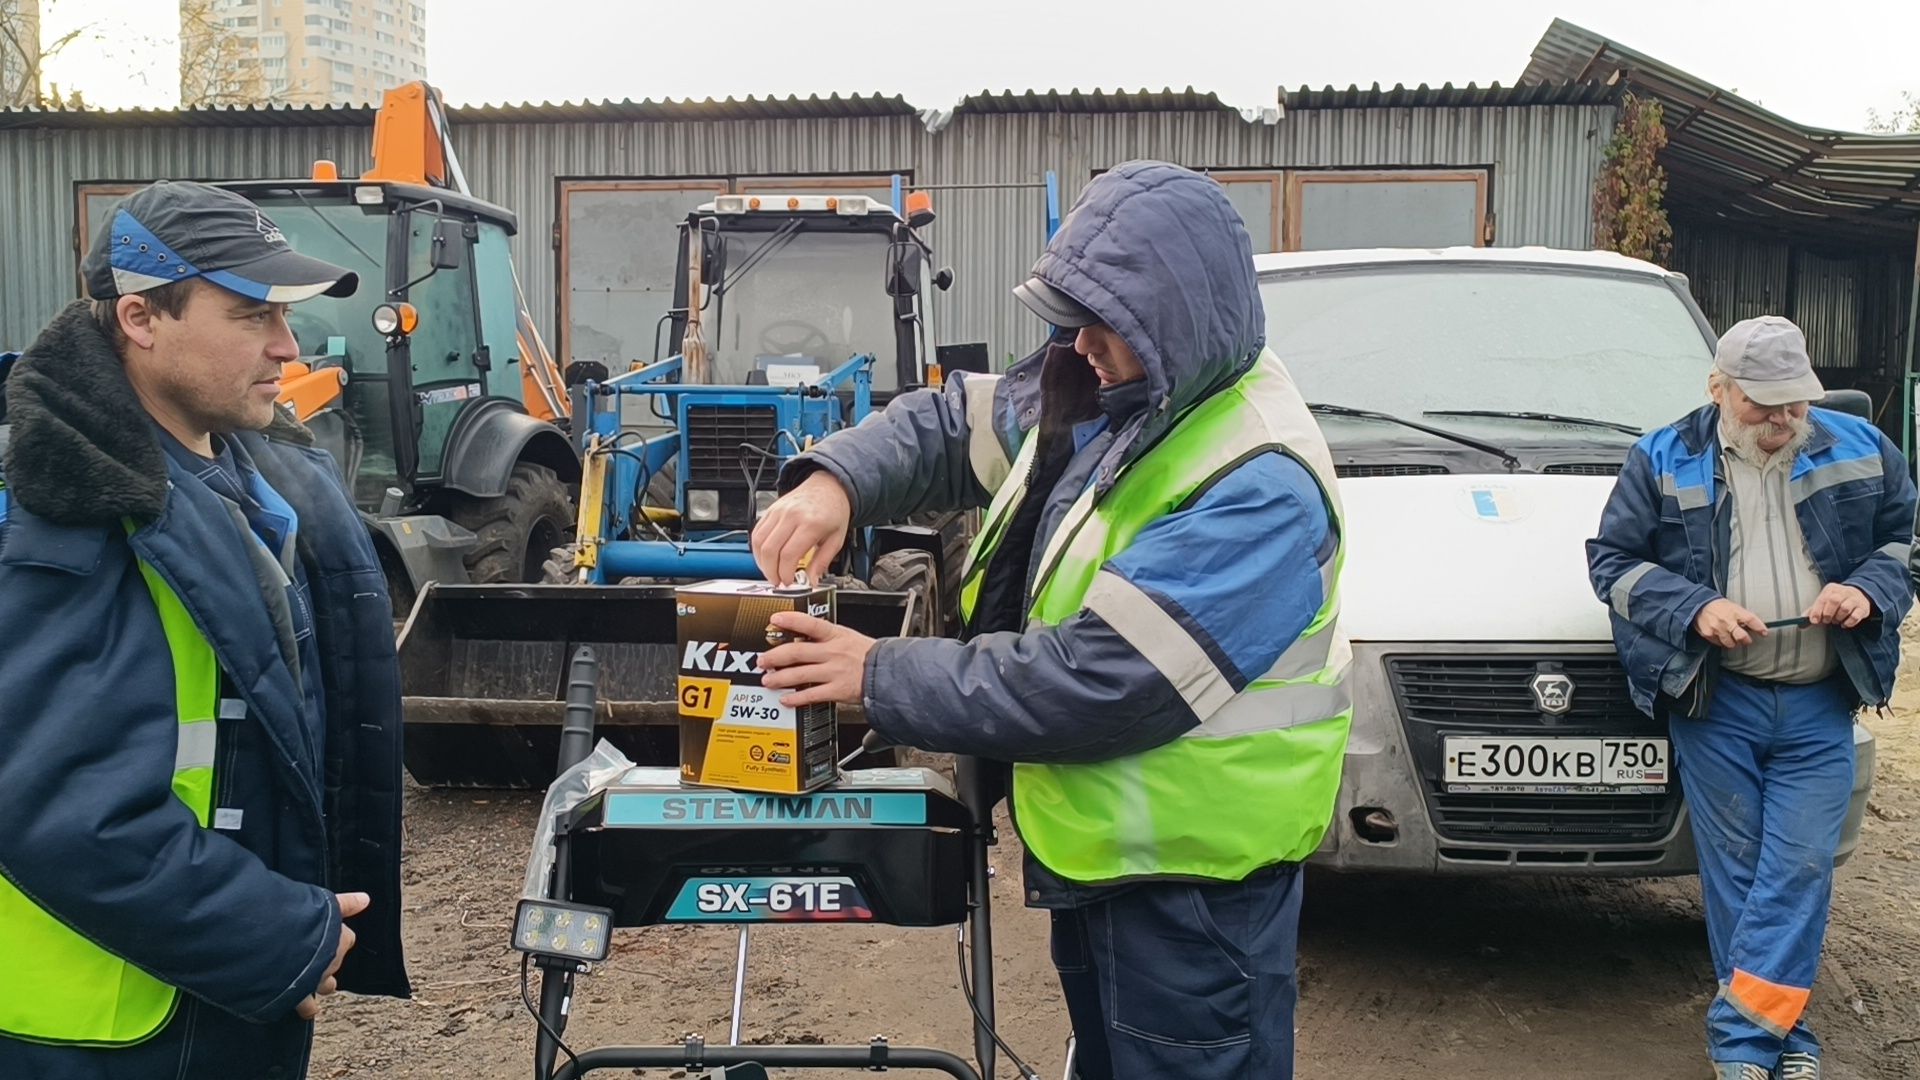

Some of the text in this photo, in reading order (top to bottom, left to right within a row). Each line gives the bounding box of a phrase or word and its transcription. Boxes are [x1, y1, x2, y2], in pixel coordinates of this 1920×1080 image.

[682, 685, 712, 709] G1
[732, 693, 763, 703] API SP
[730, 706, 780, 720] 5W-30
[1604, 742, 1658, 768] 750
[1616, 769, 1643, 779] RUS
[662, 796, 873, 820] STEVIMAN
[697, 882, 842, 913] SX-61E
